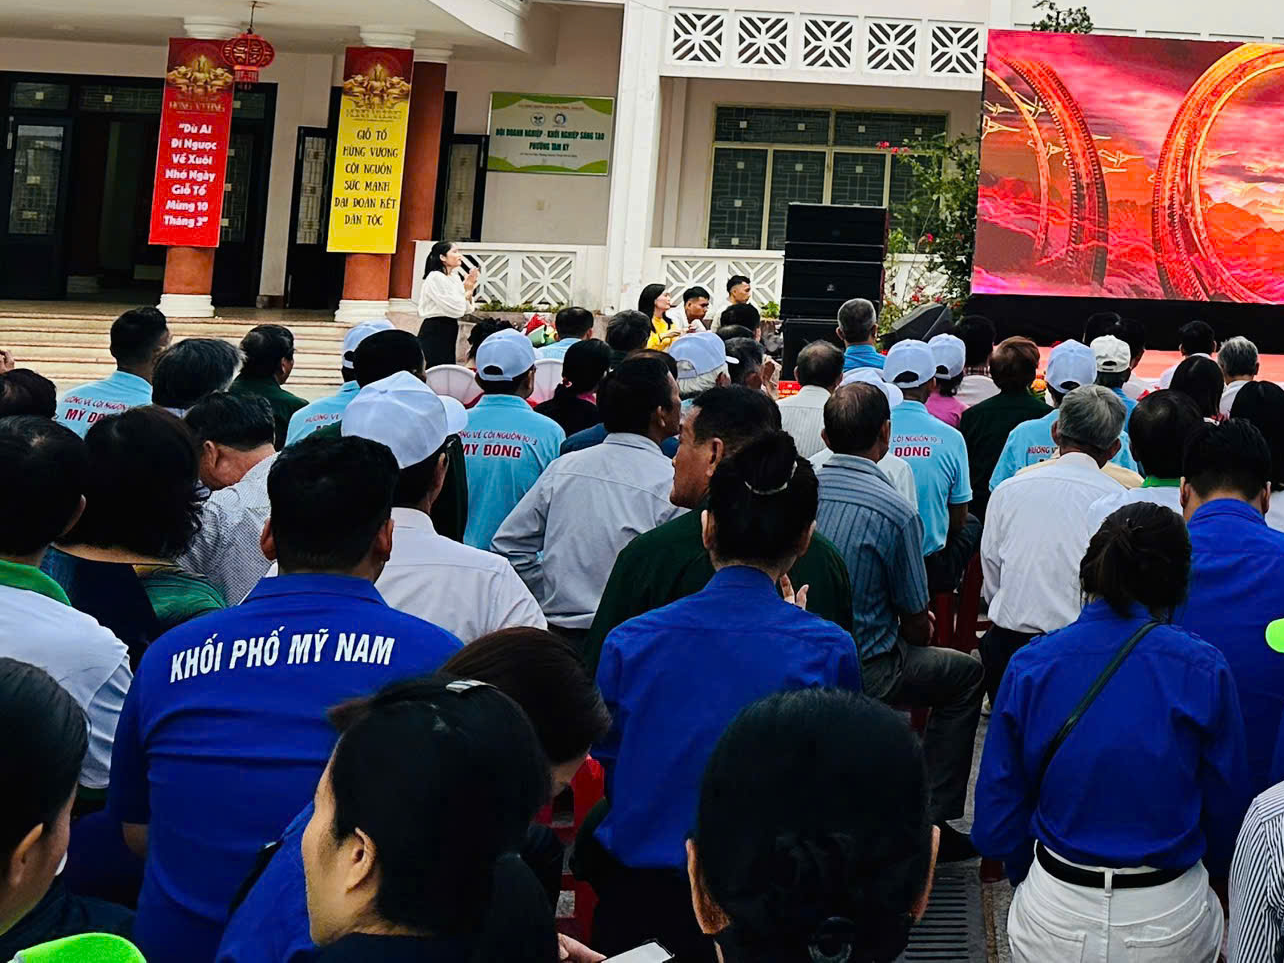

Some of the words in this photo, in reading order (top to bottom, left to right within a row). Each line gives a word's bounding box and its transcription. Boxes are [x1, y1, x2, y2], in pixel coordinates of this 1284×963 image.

[197, 202, 208, 211] 10
[484, 442, 521, 458] ĐÔNG
[894, 445, 930, 457] ĐÔNG
[170, 633, 224, 684] KHỐI
[229, 626, 285, 670] PHỐ
[287, 628, 329, 665] MỸ
[334, 632, 395, 666] NAM
